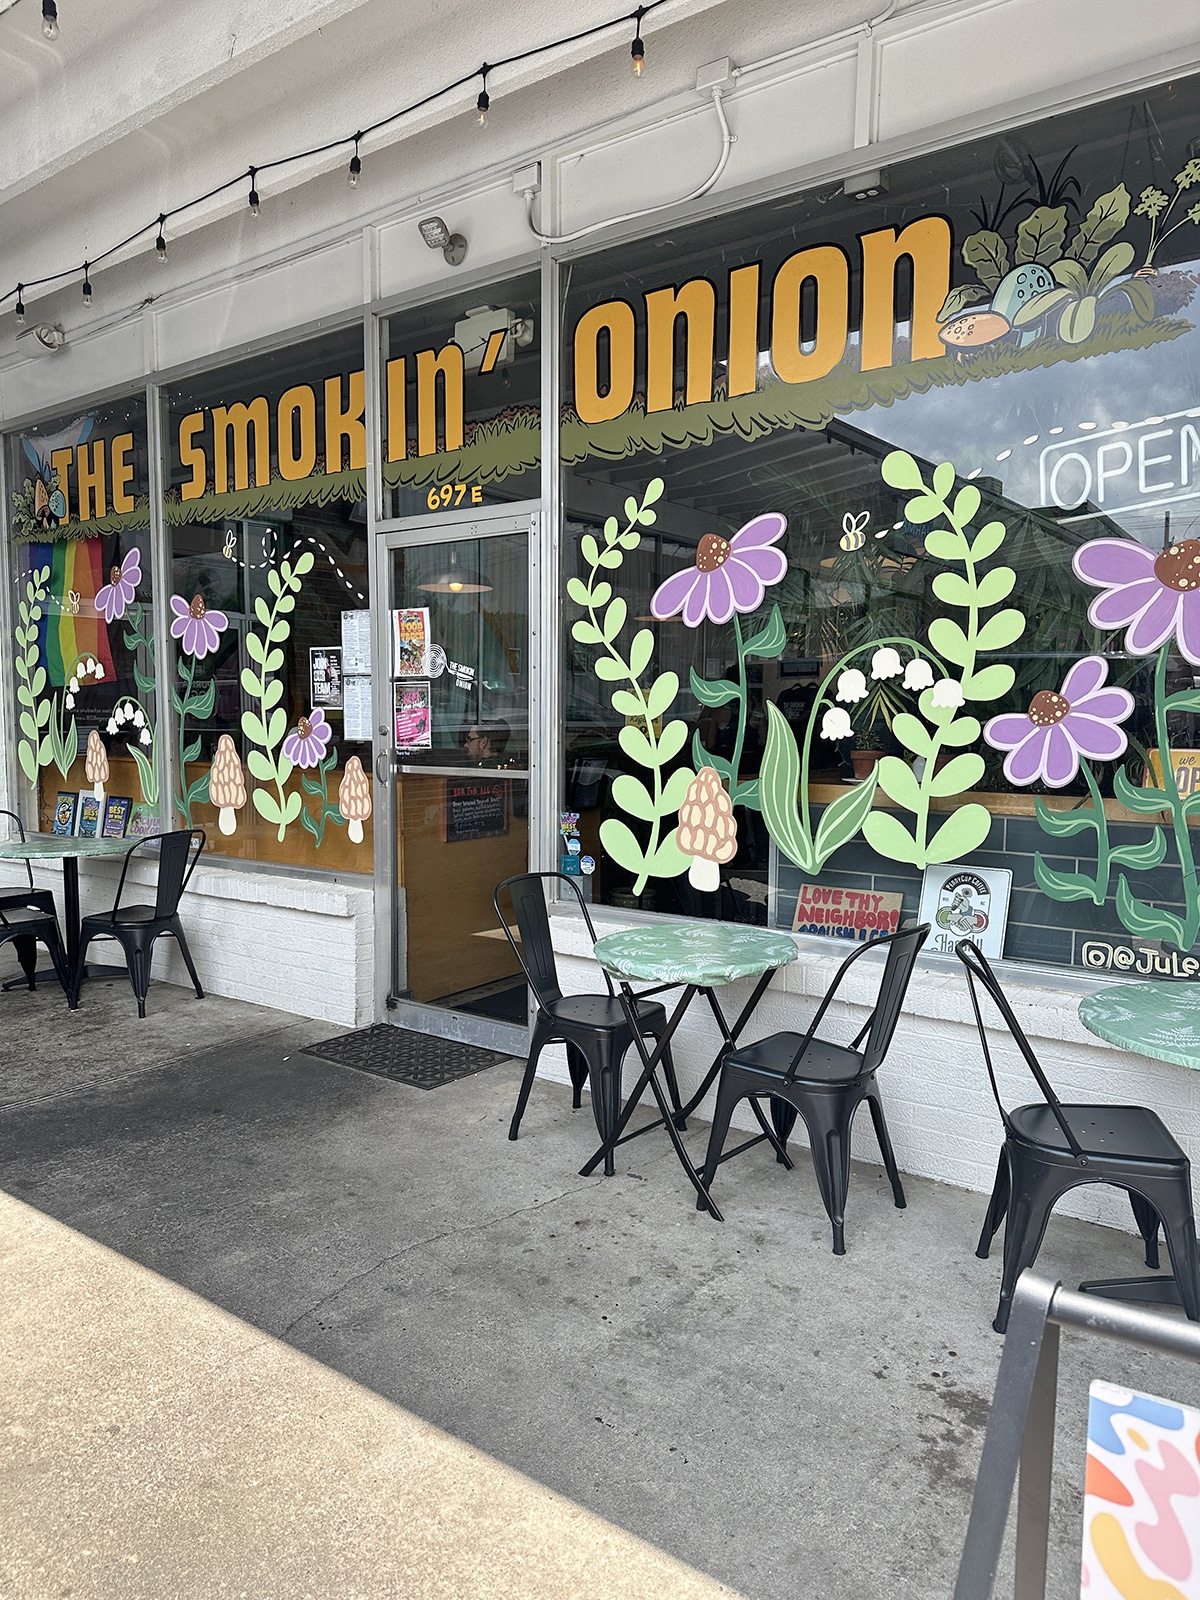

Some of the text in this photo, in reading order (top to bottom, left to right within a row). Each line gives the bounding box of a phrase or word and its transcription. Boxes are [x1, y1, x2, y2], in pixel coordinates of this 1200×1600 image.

[51, 431, 135, 525] THE
[427, 483, 482, 510] 697 E
[313, 682, 330, 695] TEAM
[109, 805, 125, 815] BEST
[801, 886, 884, 913] LOVE THY
[797, 904, 899, 933] NEIGHBOR!
